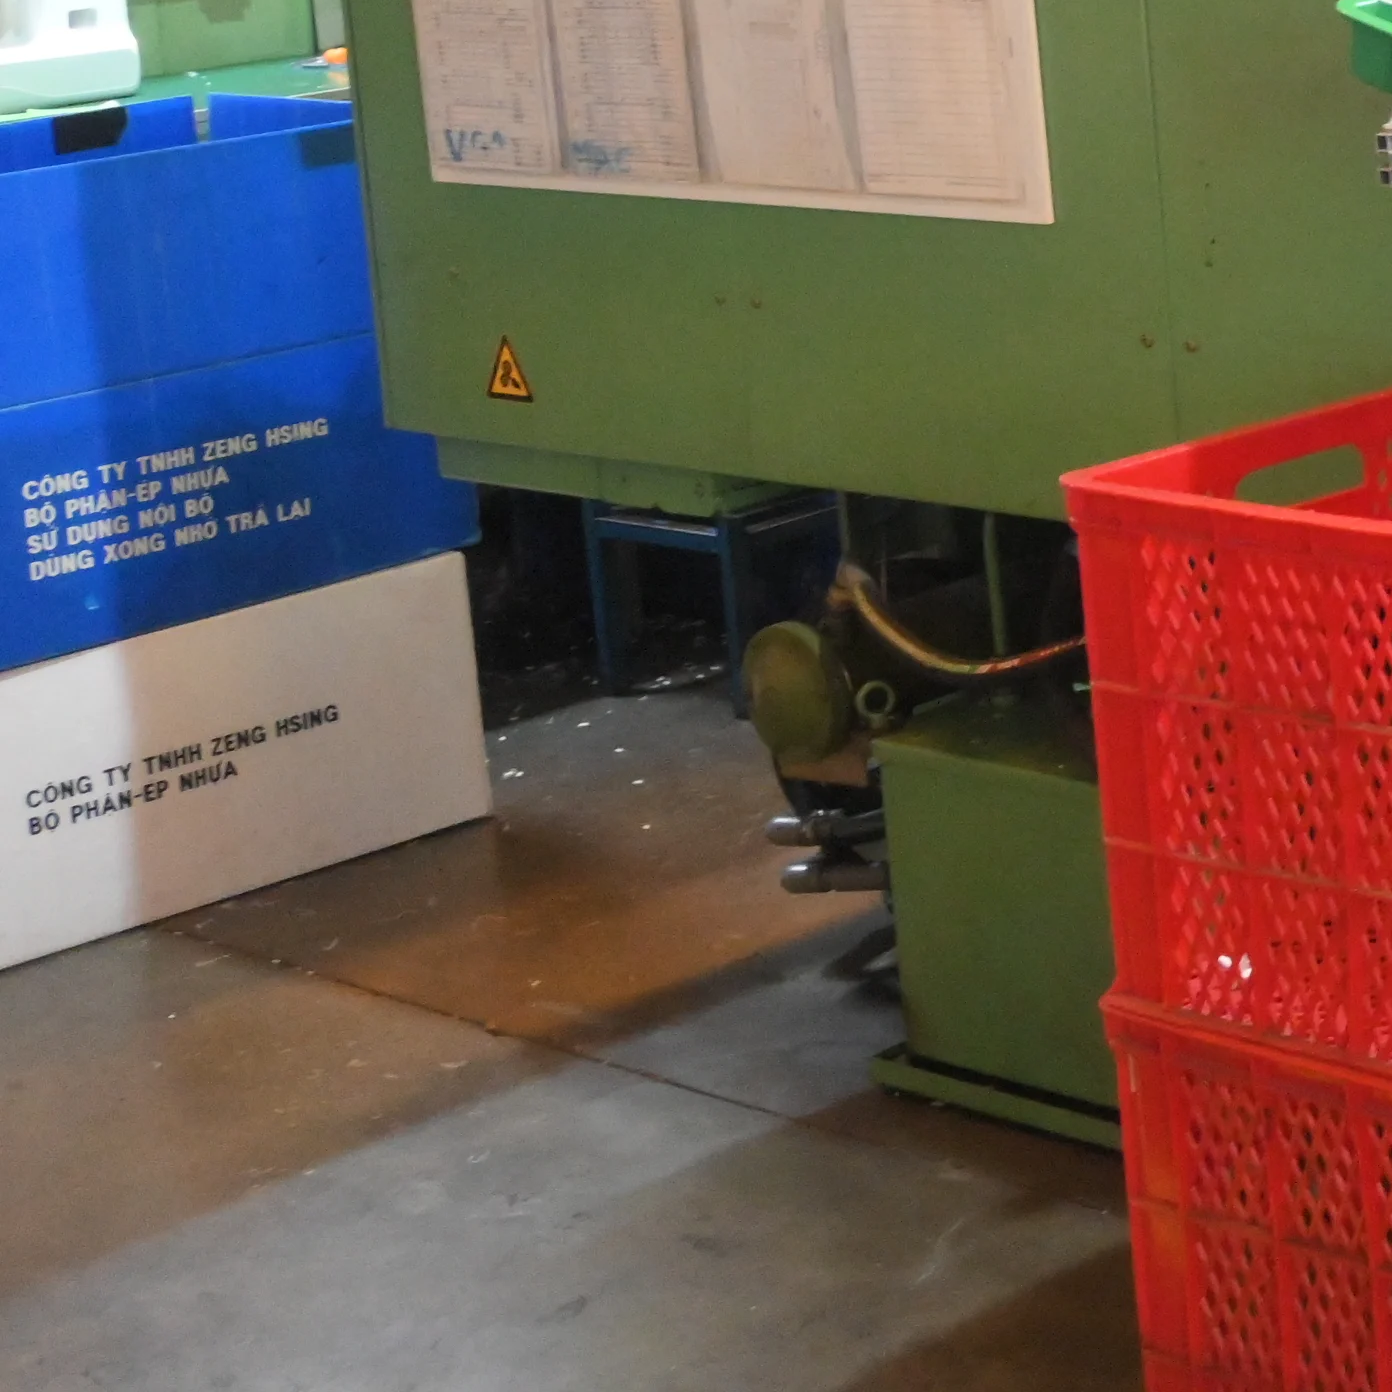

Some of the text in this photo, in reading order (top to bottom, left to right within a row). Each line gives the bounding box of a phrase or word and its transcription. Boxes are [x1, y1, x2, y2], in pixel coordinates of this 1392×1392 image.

[22, 418, 329, 500] CÔNG TY TNHH ZENG HSING
[24, 501, 57, 528] BỘ
[103, 533, 166, 565] XONG
[26, 704, 339, 808] CÔNG TY TNHH ZENG HSING
